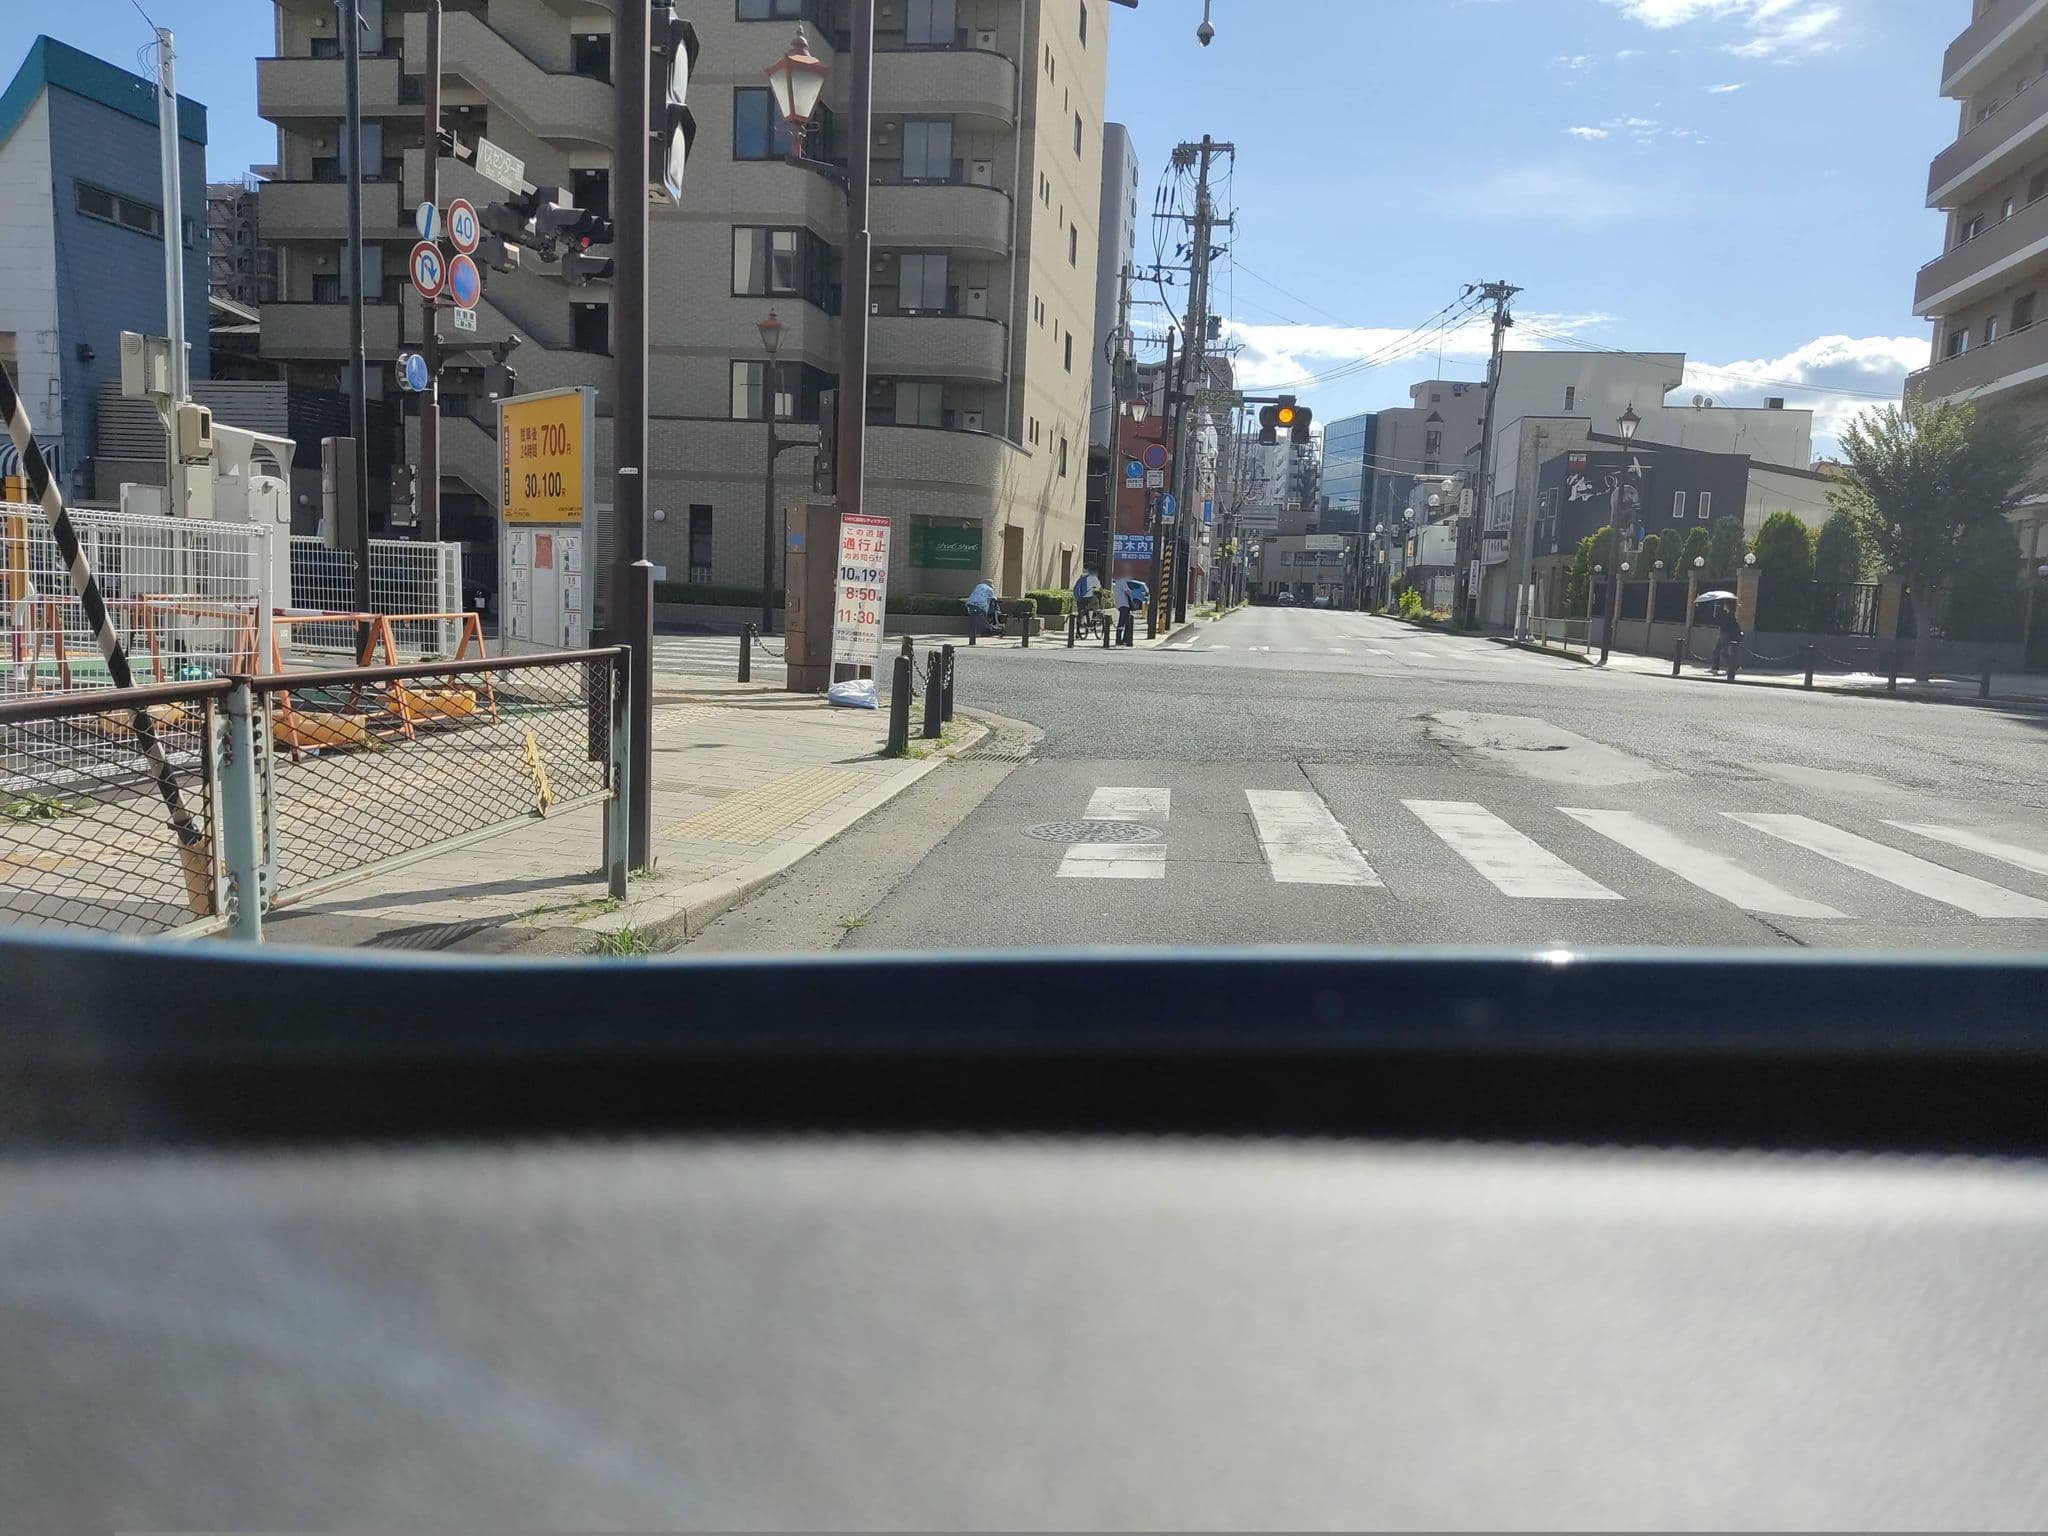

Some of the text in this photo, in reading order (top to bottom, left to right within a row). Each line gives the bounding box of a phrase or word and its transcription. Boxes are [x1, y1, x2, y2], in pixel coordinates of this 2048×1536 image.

[456, 214, 473, 240] 40
[843, 537, 887, 553] 通行止
[845, 553, 882, 562] のお知らせ
